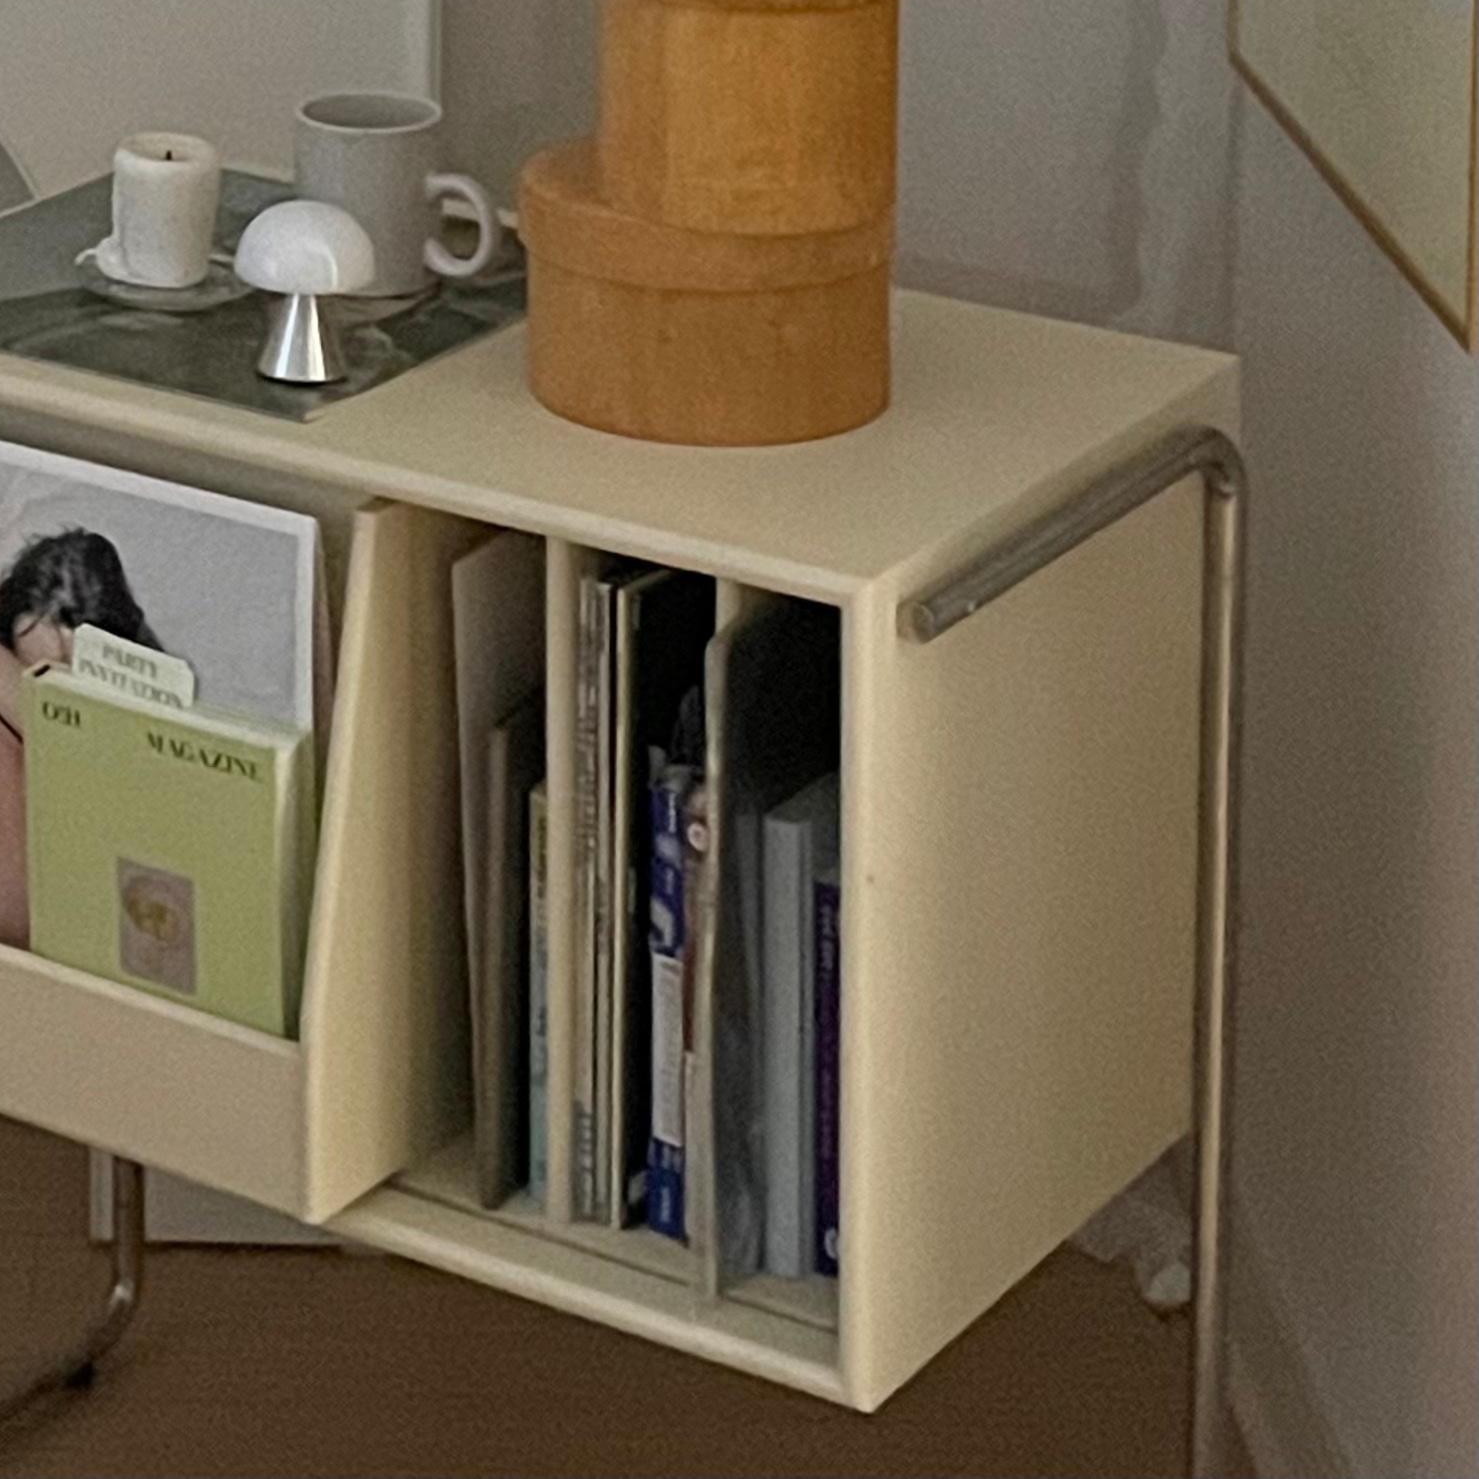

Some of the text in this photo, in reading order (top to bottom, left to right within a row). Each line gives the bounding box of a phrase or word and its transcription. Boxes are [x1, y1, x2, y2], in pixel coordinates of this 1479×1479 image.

[79, 658, 184, 711] INVITATION
[102, 642, 158, 680] PARTY
[146, 730, 264, 782] MAGAZINE
